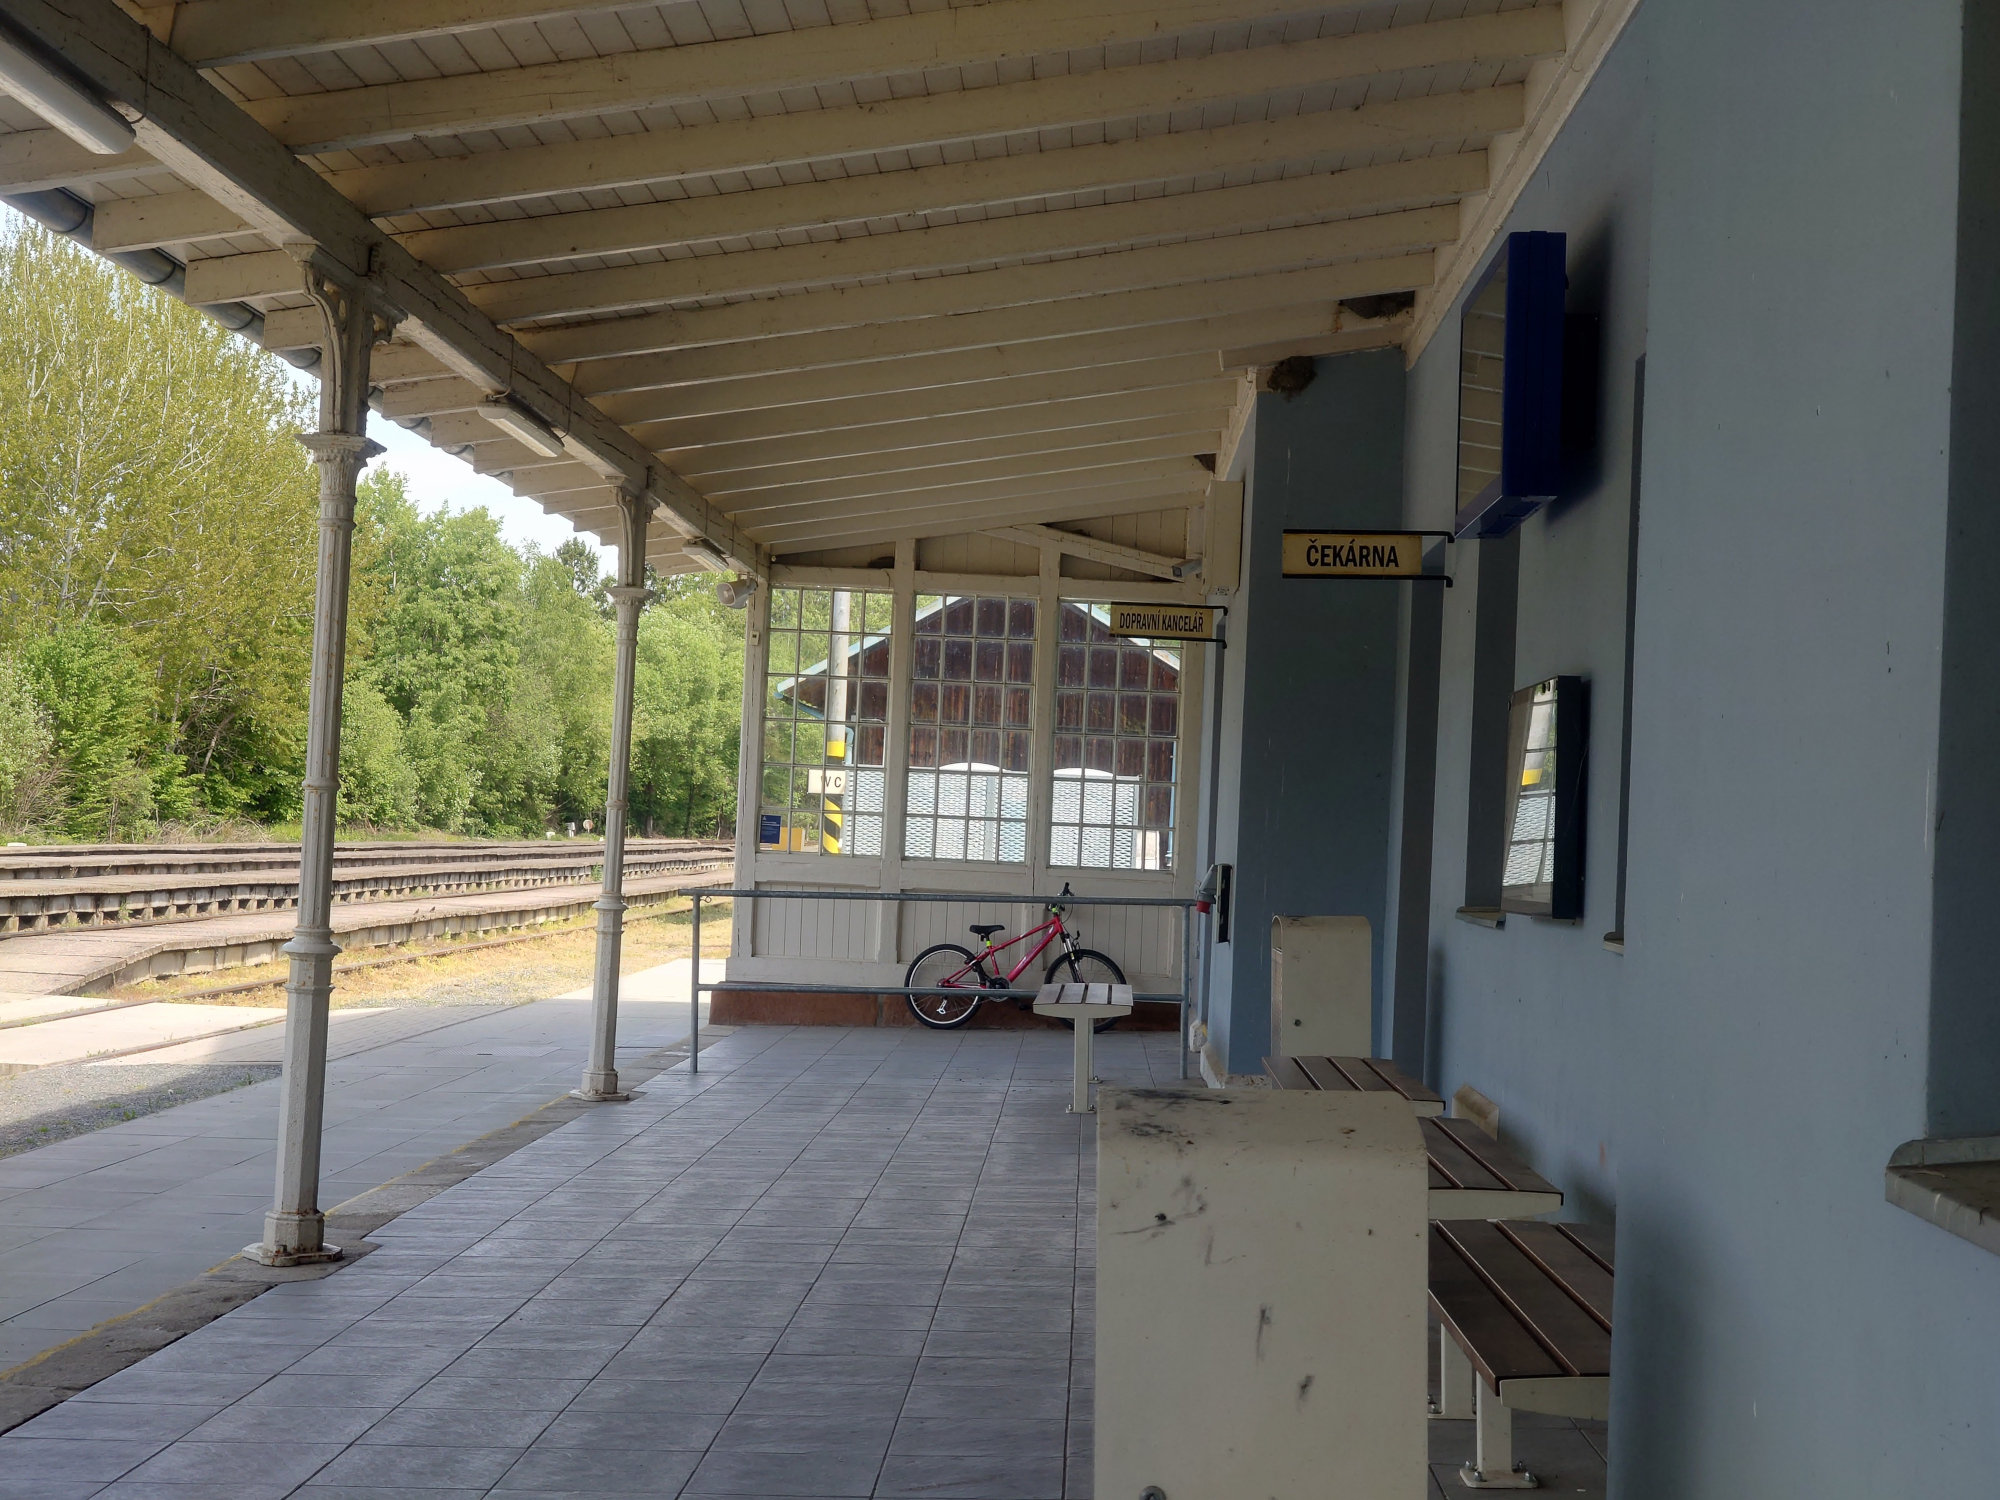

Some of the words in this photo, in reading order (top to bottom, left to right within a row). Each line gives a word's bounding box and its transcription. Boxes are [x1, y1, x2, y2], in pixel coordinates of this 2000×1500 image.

[1306, 538, 1400, 567] ČEKÁRNA
[1119, 608, 1161, 630] DOPRAVNÍ
[1161, 611, 1204, 633] KANCELÁŘ
